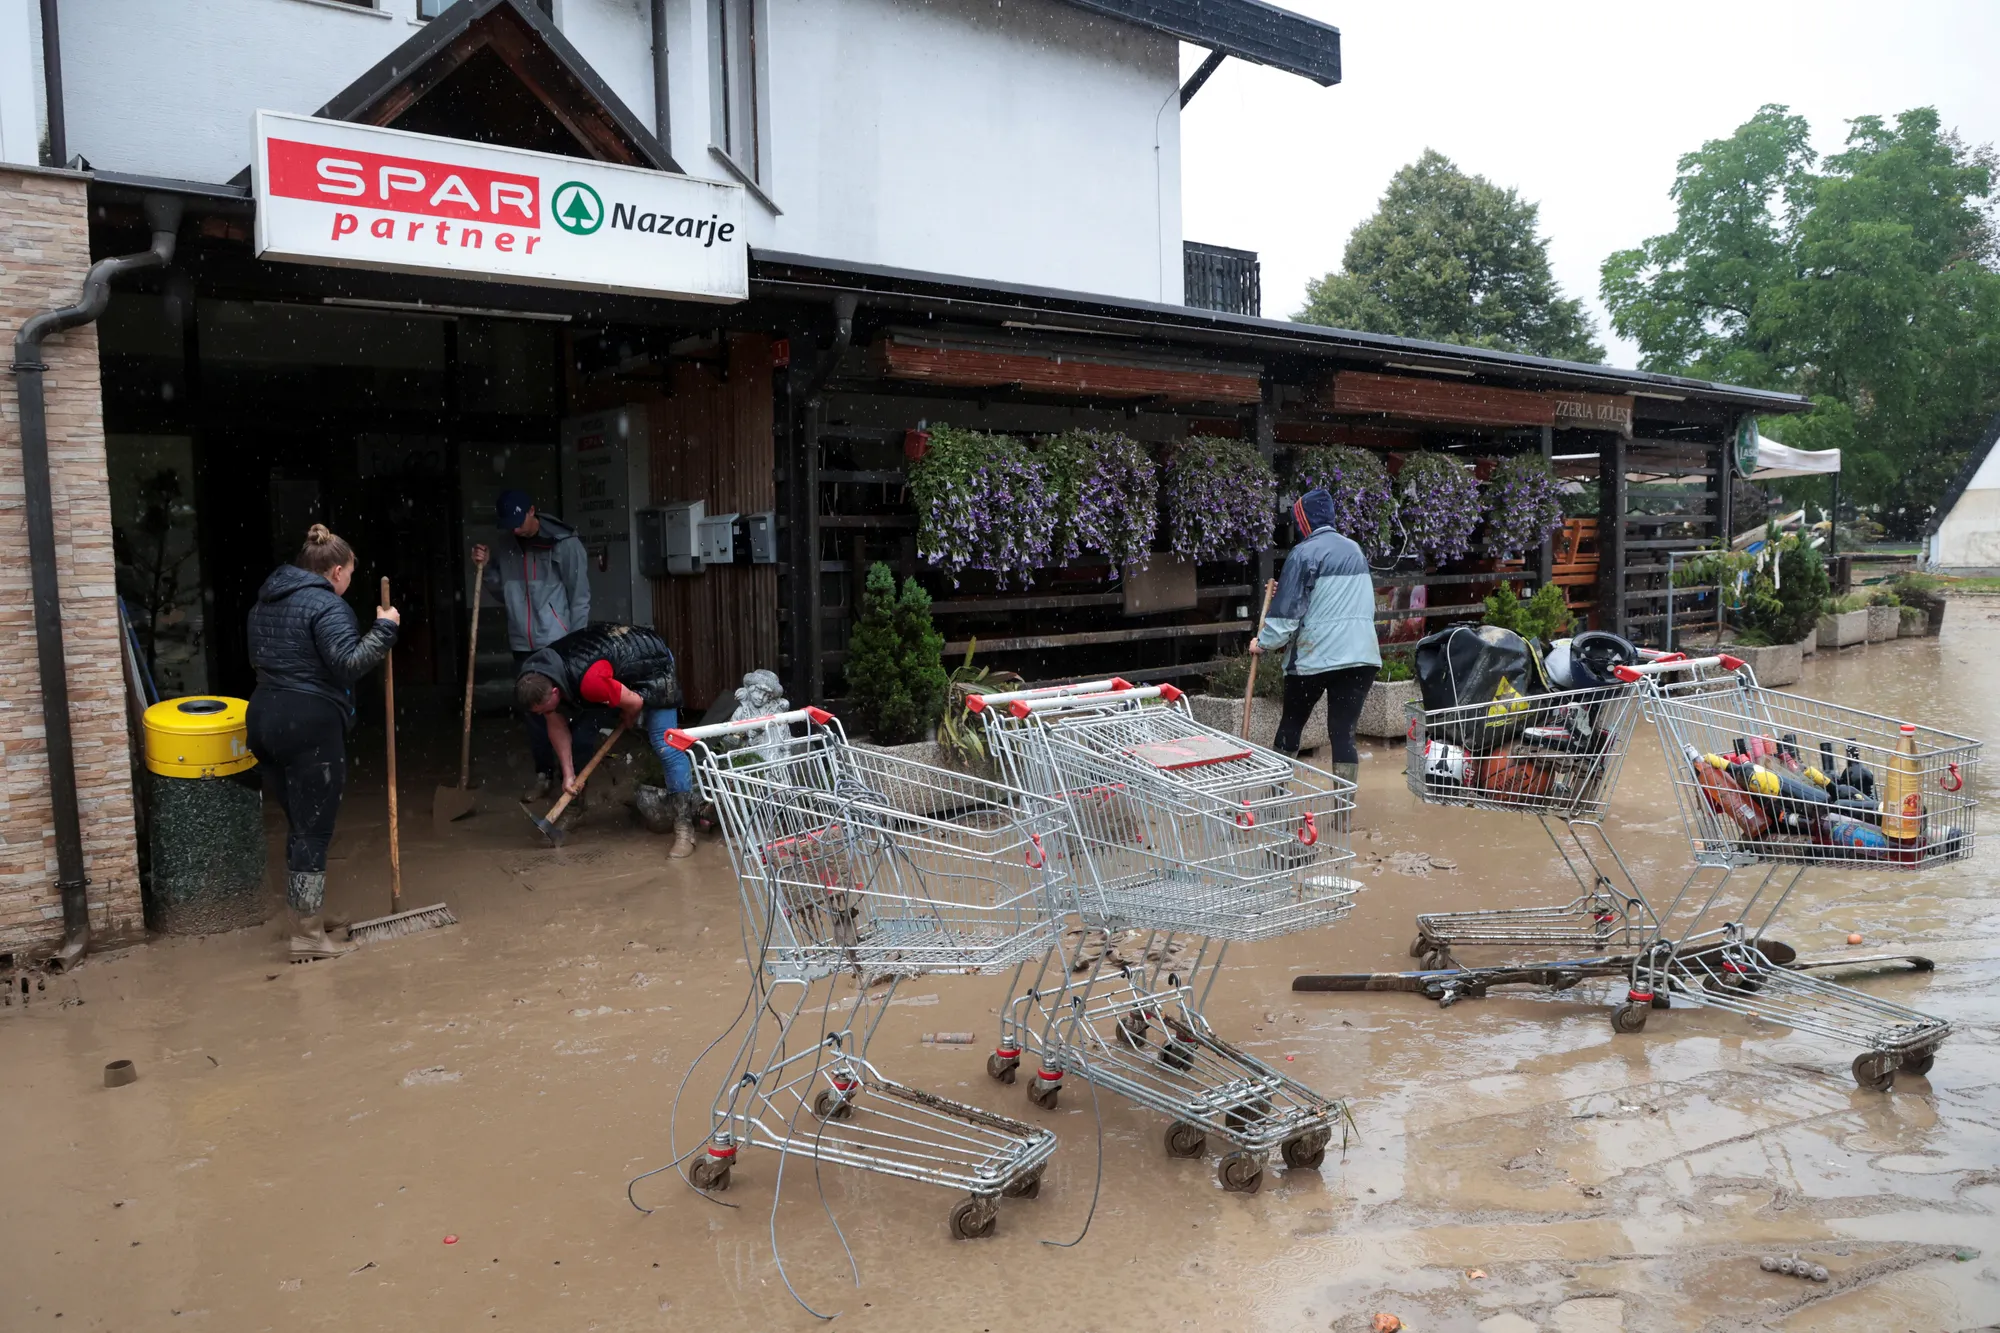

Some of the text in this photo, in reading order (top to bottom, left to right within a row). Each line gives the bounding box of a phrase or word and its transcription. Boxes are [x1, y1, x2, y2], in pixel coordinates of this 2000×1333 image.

[316, 158, 533, 219] SPAR
[331, 212, 541, 255] partner
[611, 202, 735, 248] Nazarje
